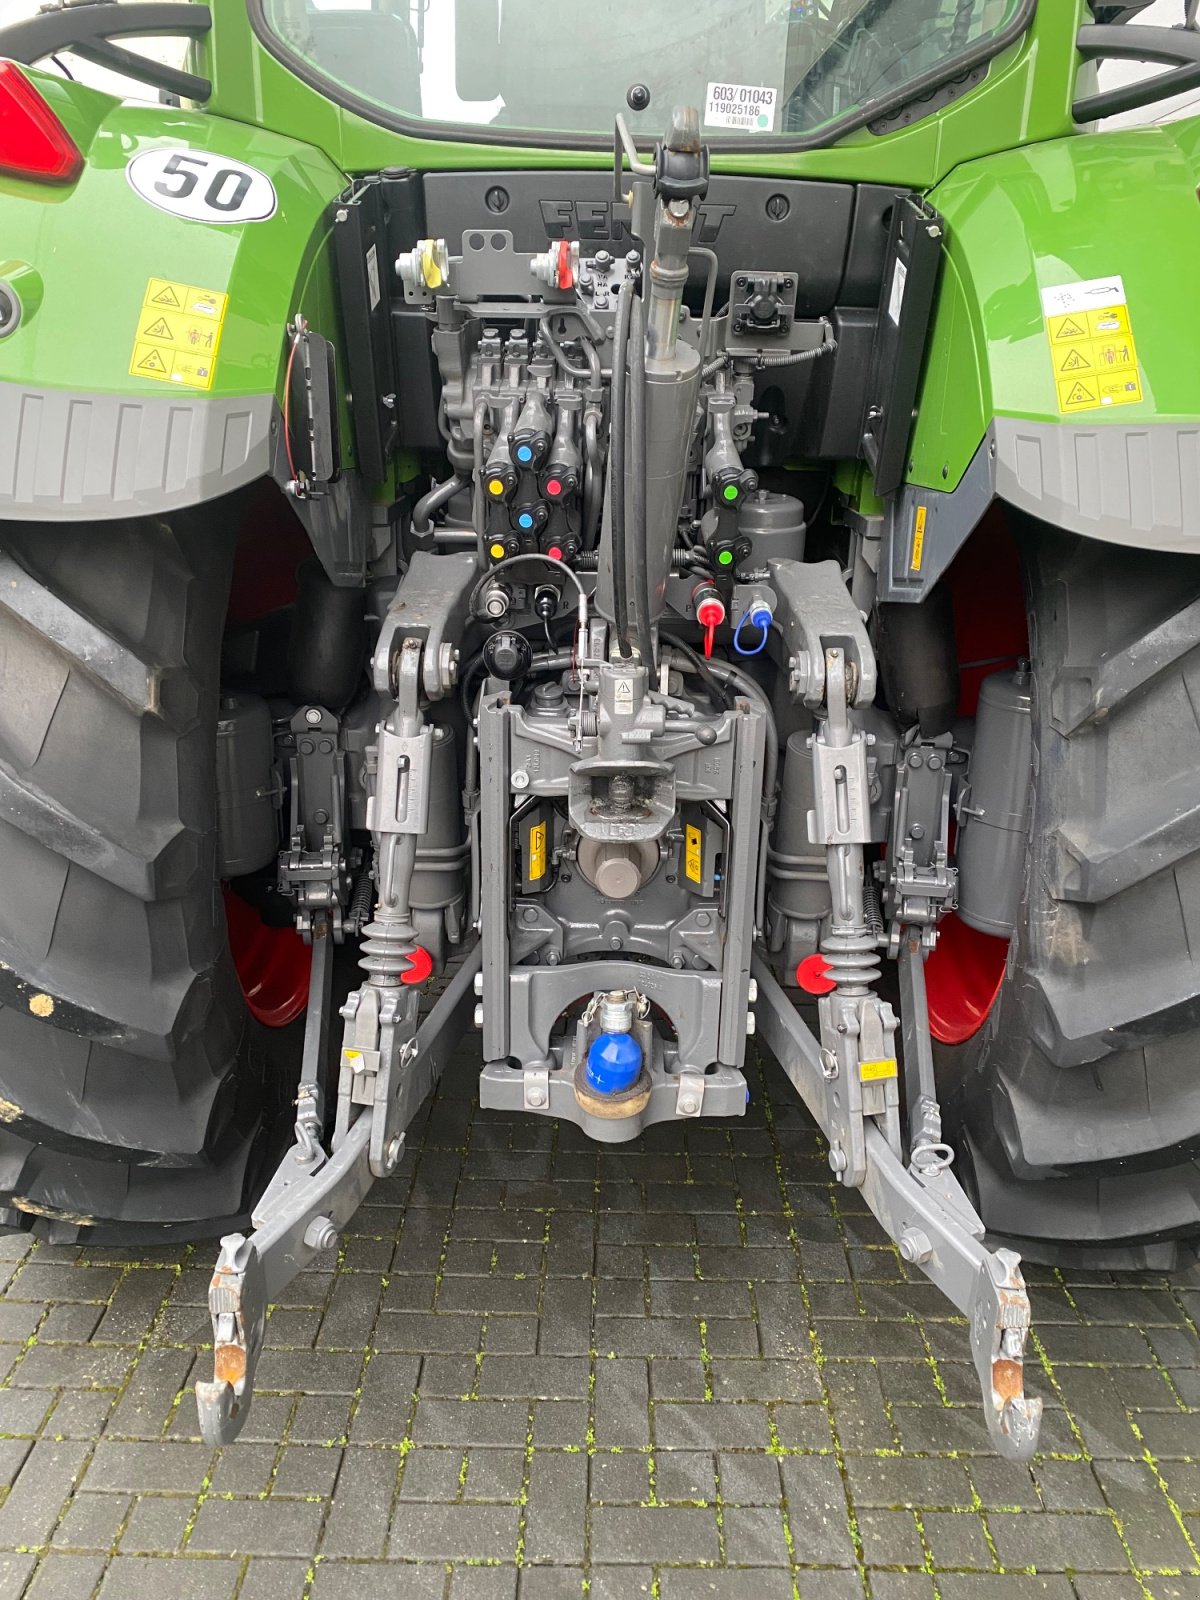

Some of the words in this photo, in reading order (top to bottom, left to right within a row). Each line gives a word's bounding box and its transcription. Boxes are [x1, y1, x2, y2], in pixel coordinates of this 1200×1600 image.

[709, 101, 760, 116] 119025186
[154, 154, 253, 211] 50
[539, 200, 737, 243] FENT
